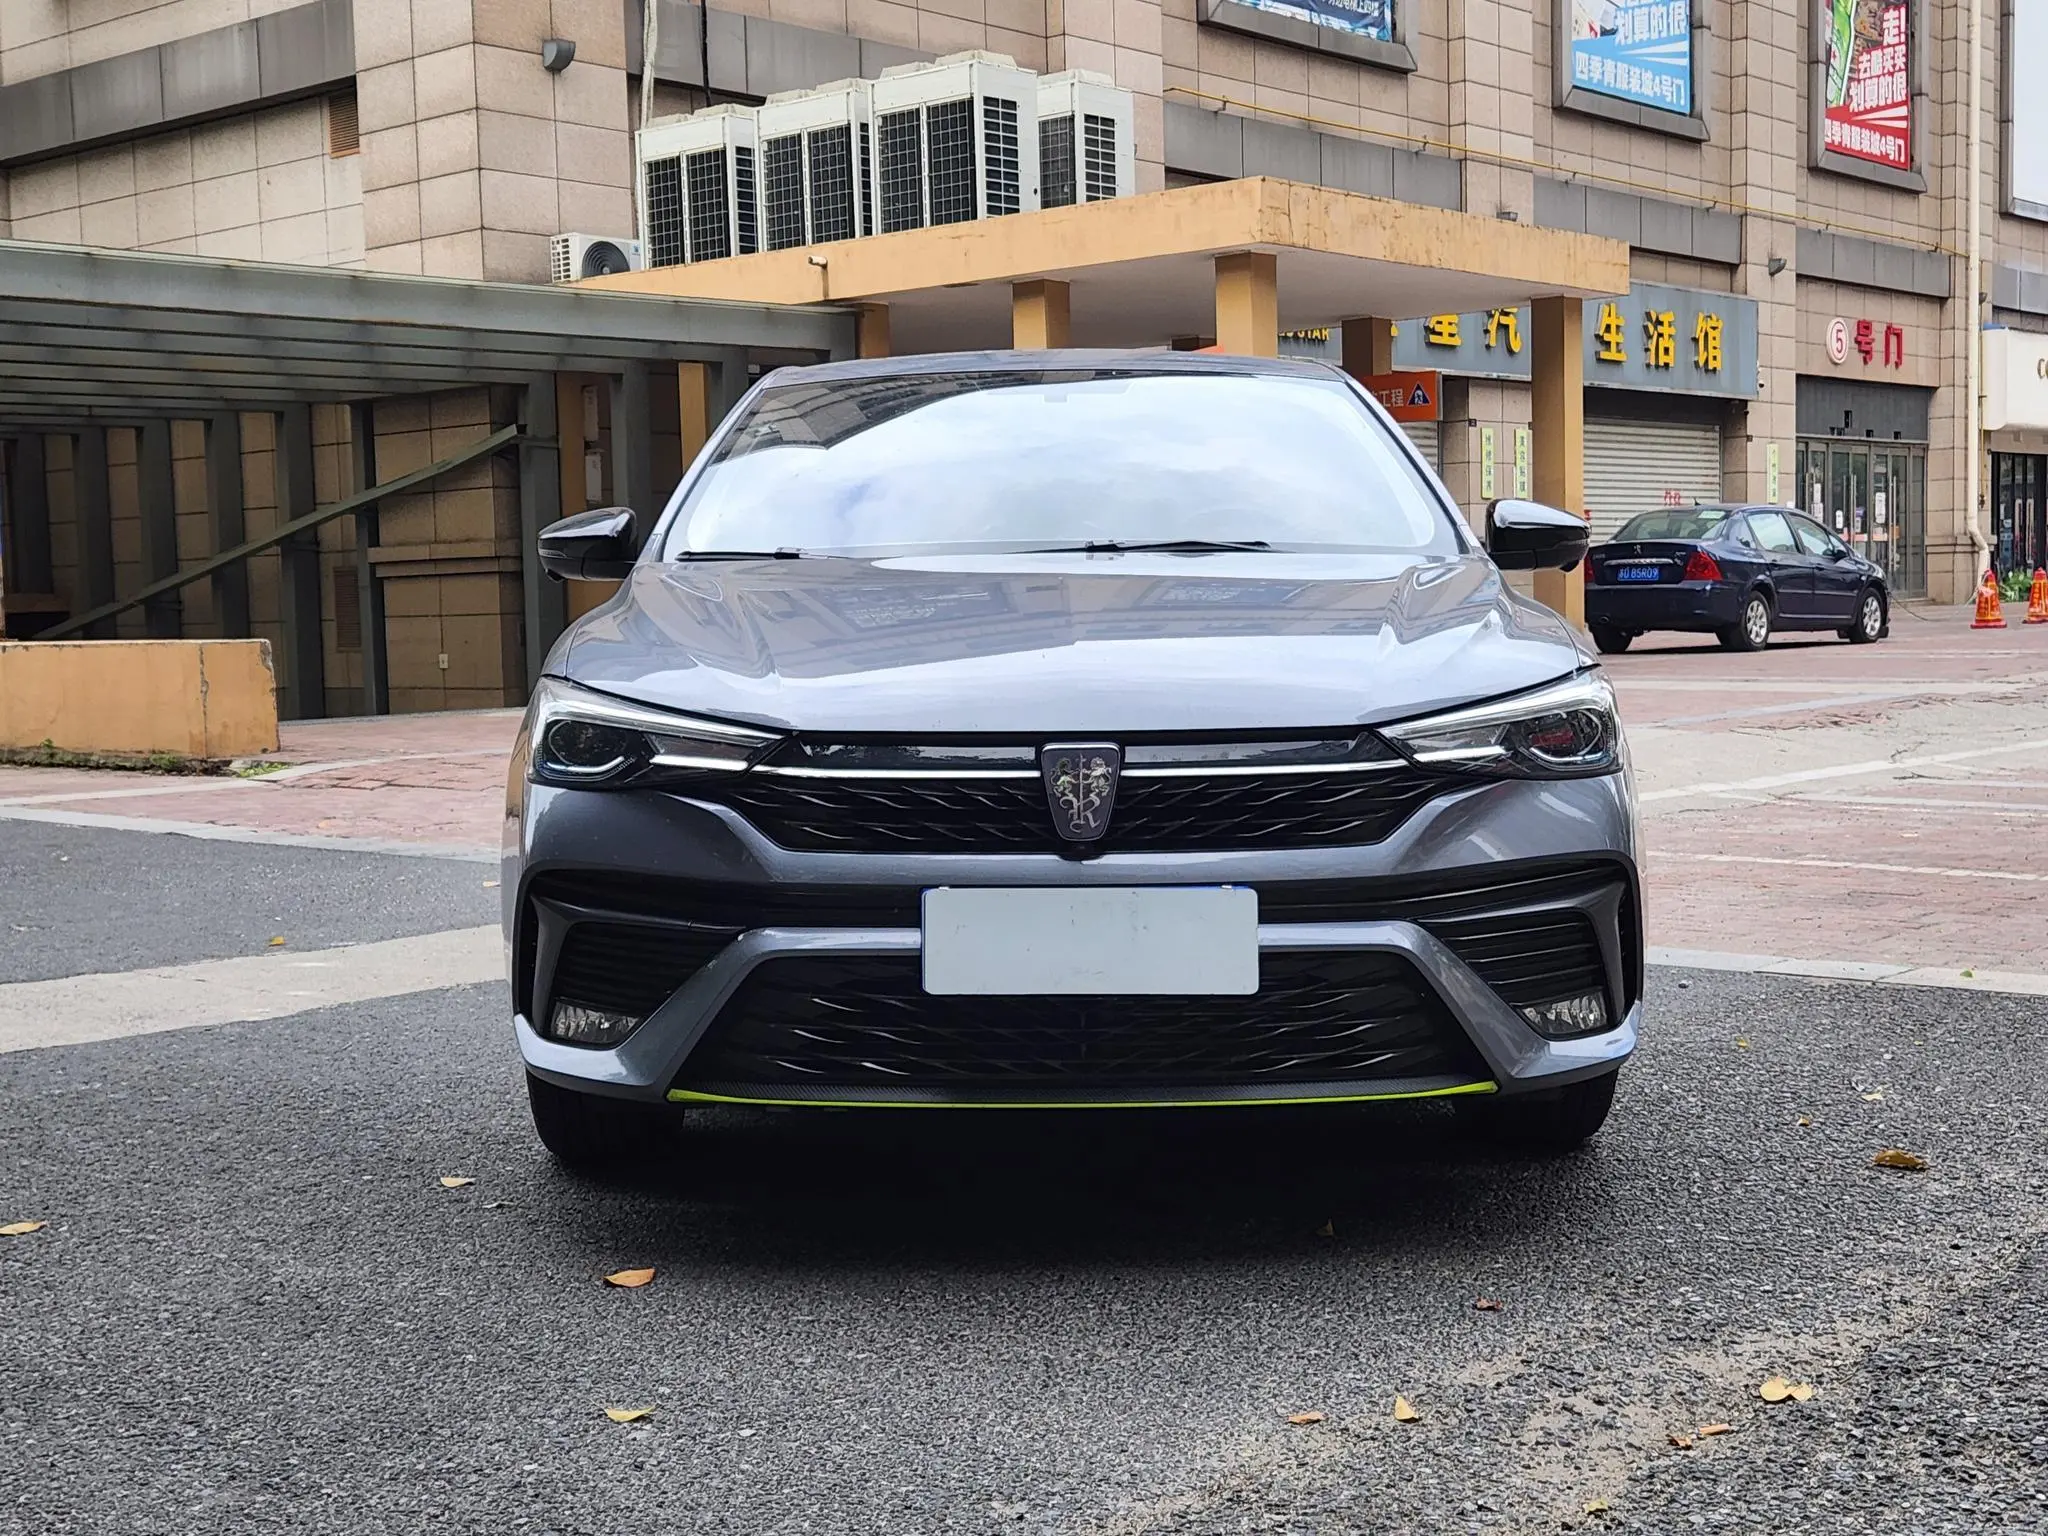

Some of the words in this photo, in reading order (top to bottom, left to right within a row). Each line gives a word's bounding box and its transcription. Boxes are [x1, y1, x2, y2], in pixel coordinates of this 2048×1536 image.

[1883, 6, 1906, 46] 走!
[1575, 50, 1687, 106] 四季青服装城4号门
[1850, 71, 1907, 112] 划算的很
[1372, 388, 1404, 408] 工程
